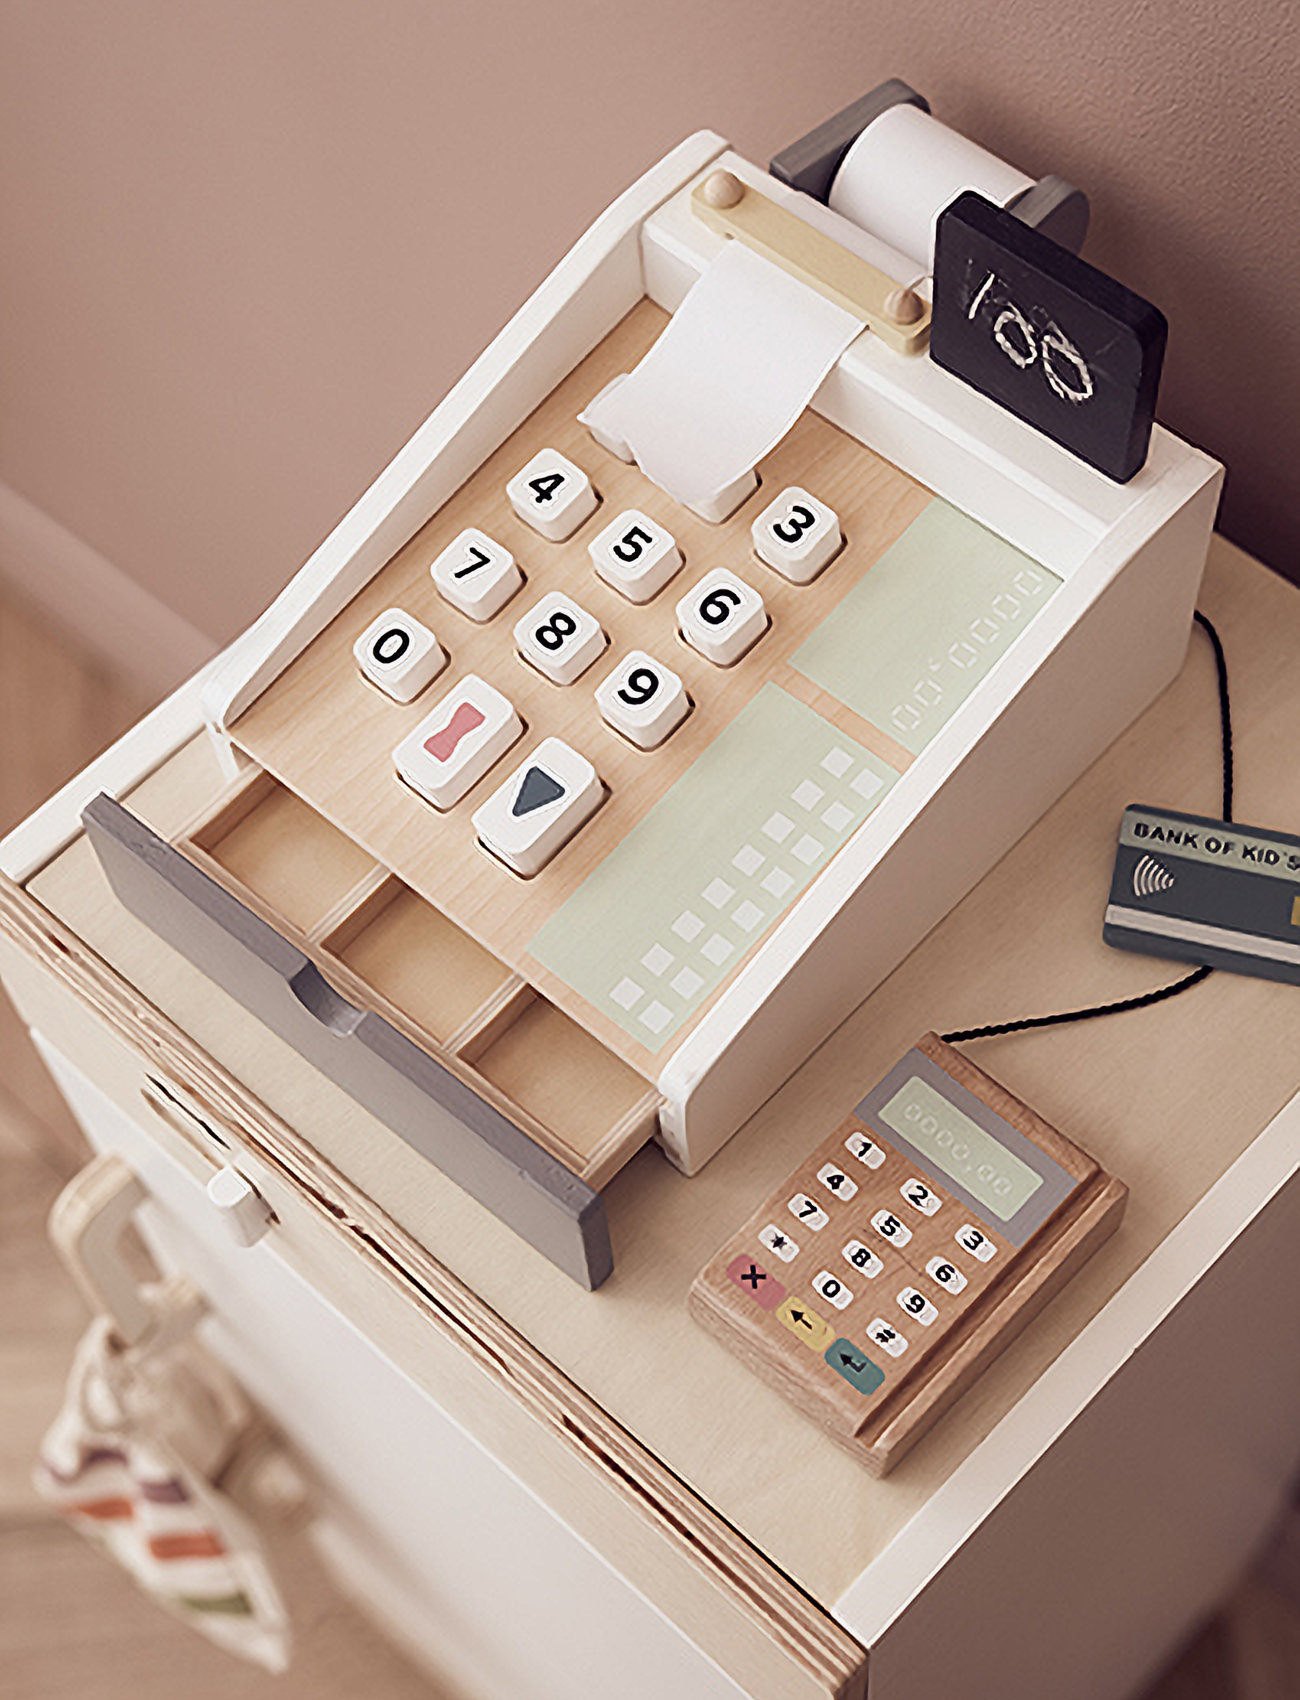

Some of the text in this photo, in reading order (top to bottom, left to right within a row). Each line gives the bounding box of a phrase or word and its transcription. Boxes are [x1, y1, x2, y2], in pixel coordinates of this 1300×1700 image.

[529, 473, 565, 503] 4
[773, 505, 816, 543] 3
[613, 526, 653, 562] 5
[454, 547, 491, 579] 7
[699, 588, 741, 625] 6
[535, 612, 577, 651] 8
[372, 628, 410, 664] 0
[617, 668, 659, 706] 9
[1134, 823, 1198, 849] BANK
[1205, 837, 1237, 854] OF
[827, 1174, 845, 1190] 4
[798, 1200, 818, 1218] 7
[907, 1184, 929, 1208] 2
[879, 1215, 901, 1237] 5
[962, 1230, 984, 1251] 3
[851, 1248, 872, 1268] 8
[935, 1264, 956, 1283] 6
[821, 1279, 841, 1298] 0
[905, 1294, 926, 1314] 9
